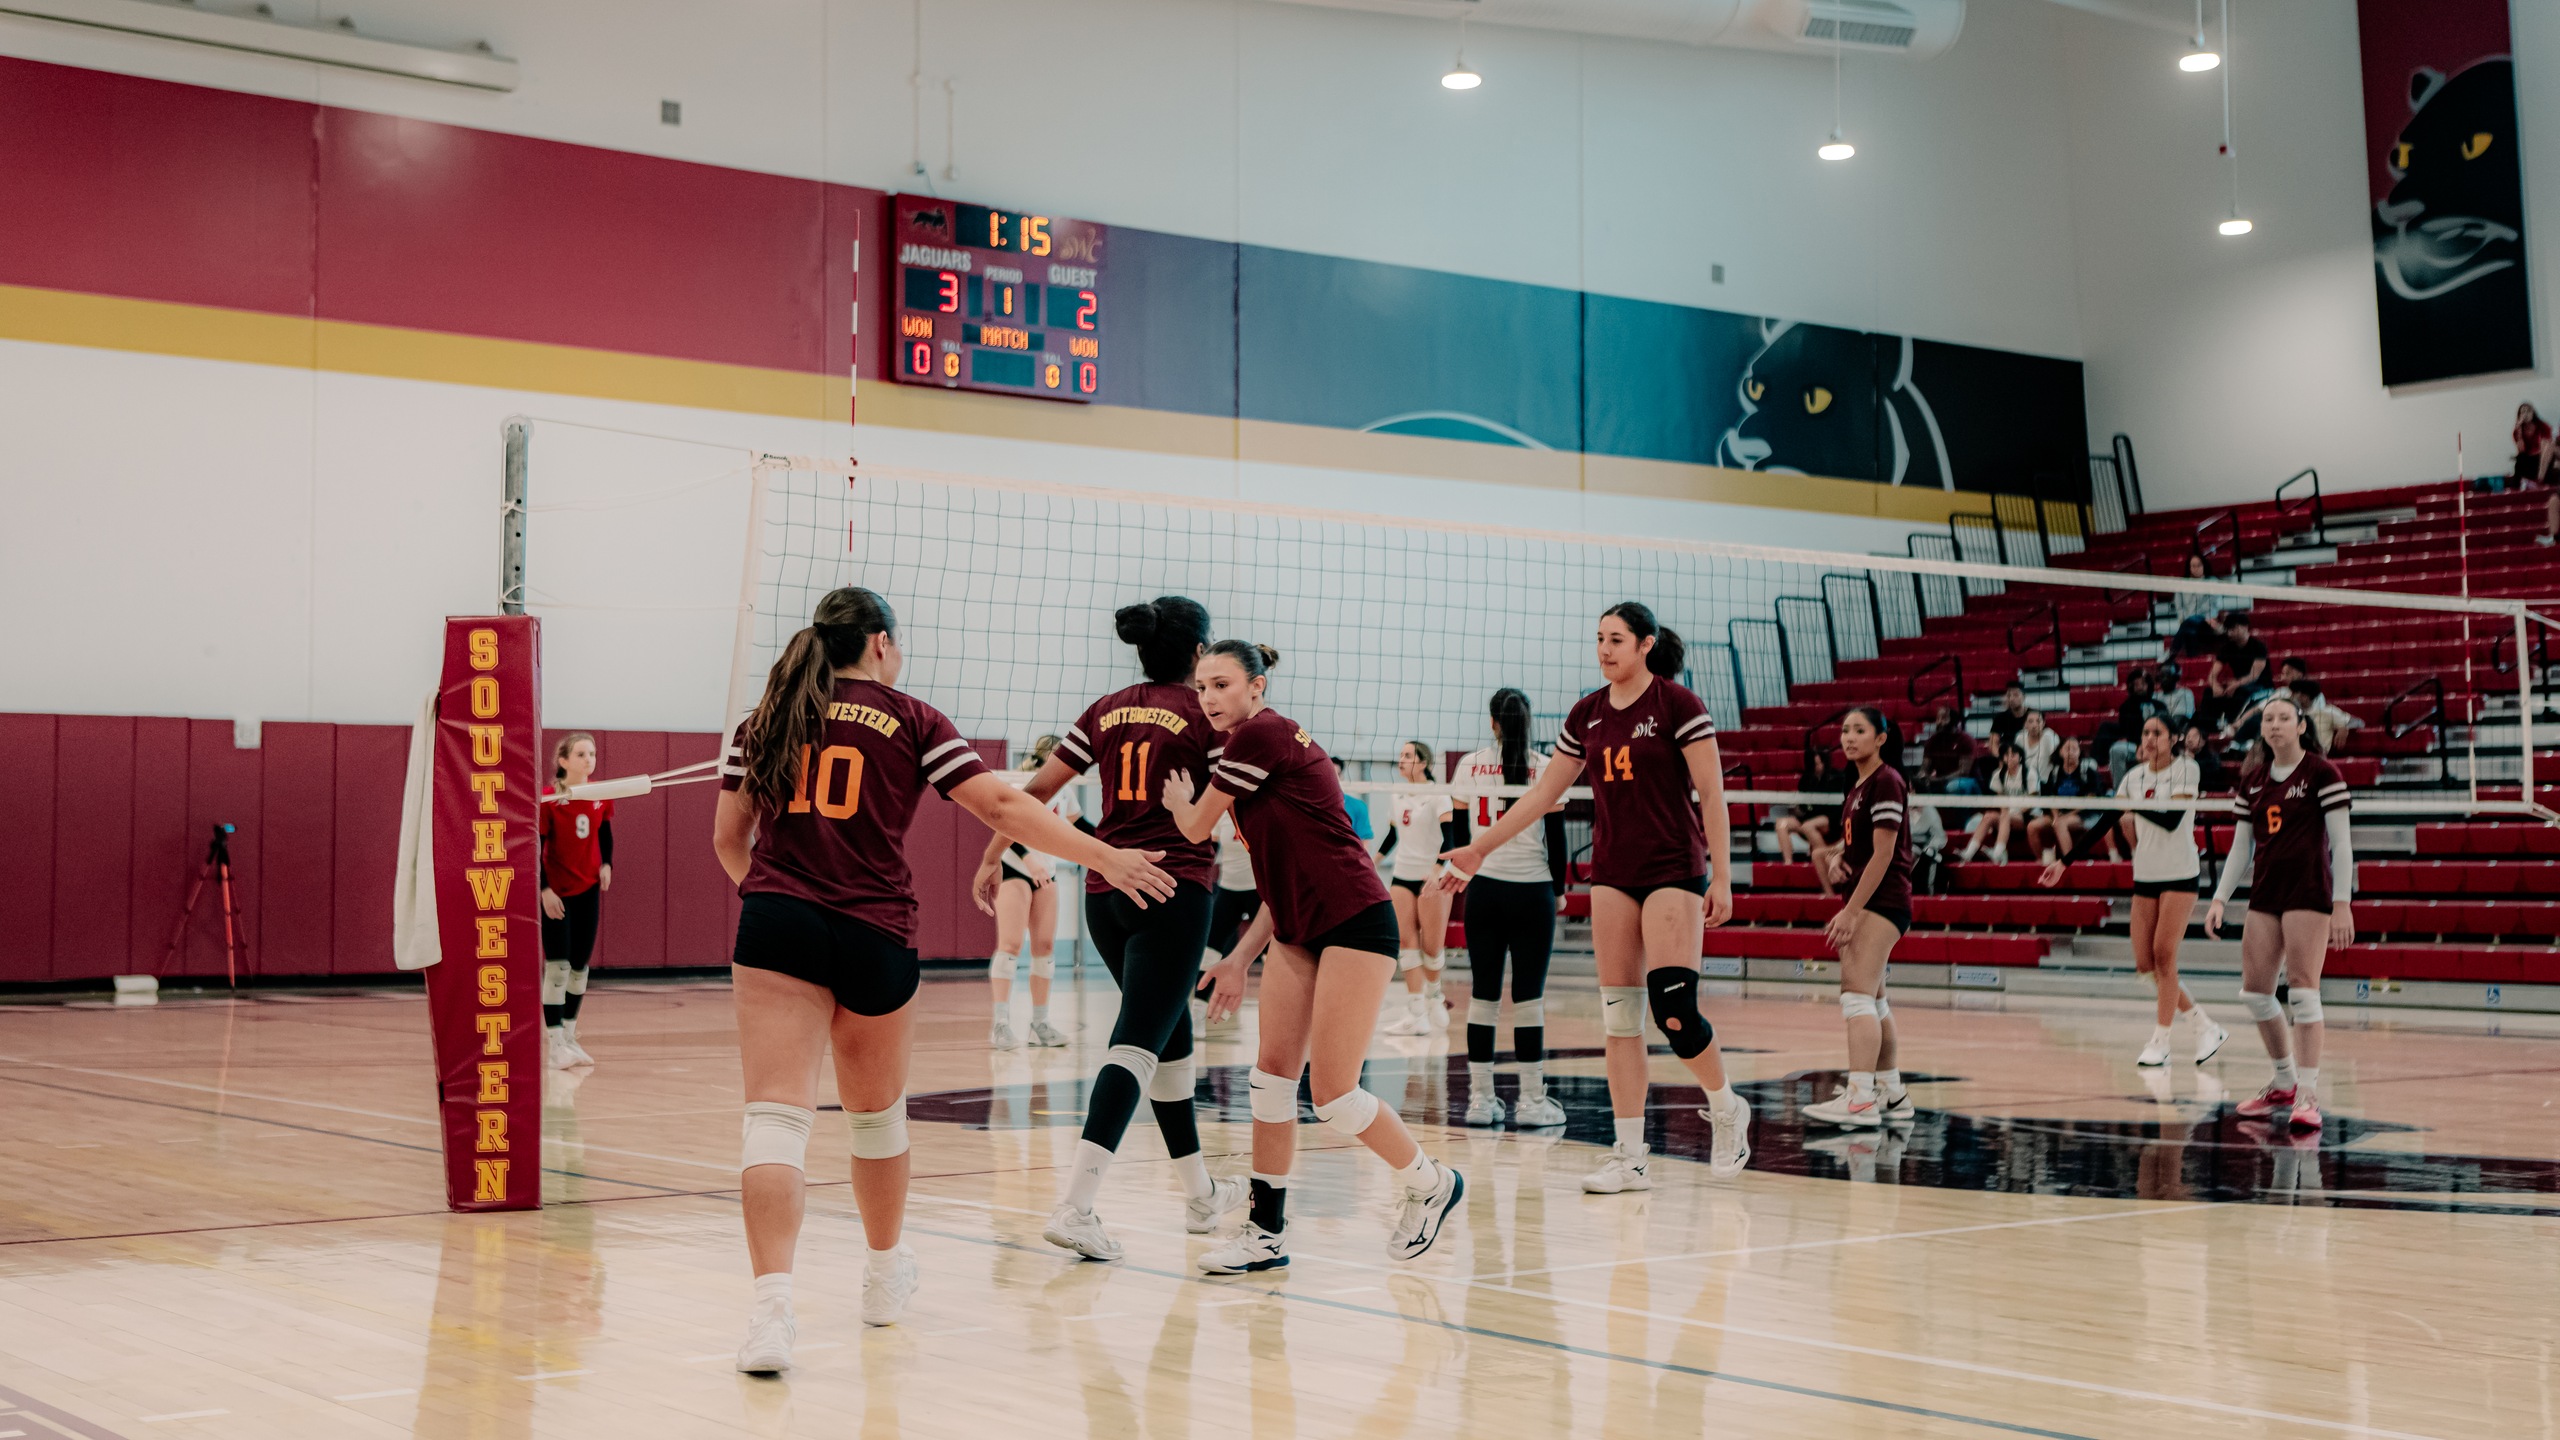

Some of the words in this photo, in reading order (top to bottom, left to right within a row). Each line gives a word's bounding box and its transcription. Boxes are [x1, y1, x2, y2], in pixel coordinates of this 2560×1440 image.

[900, 245, 972, 271] JAGUARS
[985, 266, 1023, 284] PERIOD
[1049, 266, 1097, 287] GUEST
[938, 271, 959, 313] 3
[1003, 286, 1013, 315] 1
[1076, 290, 1098, 331] 2
[902, 315, 933, 338] WON
[980, 324, 1029, 350] MATCH
[912, 341, 931, 375] 0
[1069, 335, 1099, 358] WON
[1079, 362, 1097, 394] 0
[825, 702, 901, 738] WESTERN
[1100, 706, 1188, 735] SOUTHWESTERN
[1118, 741, 1150, 801] 11
[1603, 745, 1634, 782] 14
[788, 744, 864, 819] 10
[575, 813, 590, 838] 9
[2267, 805, 2282, 834] 6
[466, 629, 515, 1202] SOUTHWESTERN
